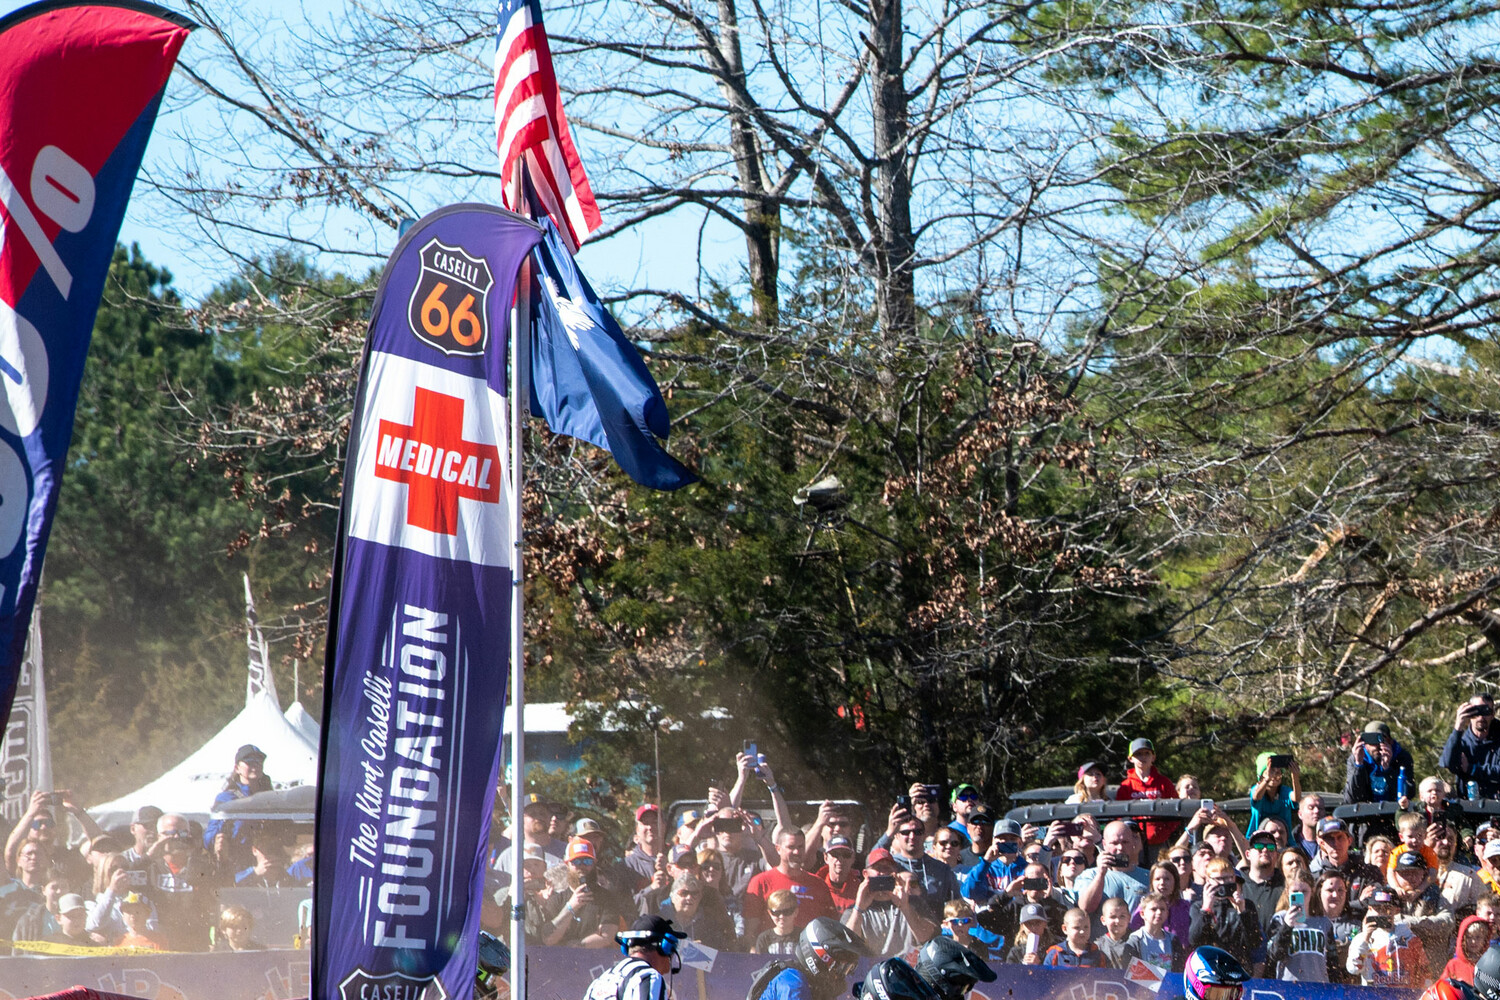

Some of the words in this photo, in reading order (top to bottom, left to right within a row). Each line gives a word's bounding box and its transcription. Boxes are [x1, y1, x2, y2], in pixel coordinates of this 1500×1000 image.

[432, 249, 480, 286] CASELLI
[420, 282, 483, 344] 66
[377, 433, 492, 490] MEDICAL
[360, 670, 393, 762] Caselli
[354, 760, 385, 821] Kurt
[373, 603, 449, 950] FOUNDATION
[349, 821, 378, 869] The
